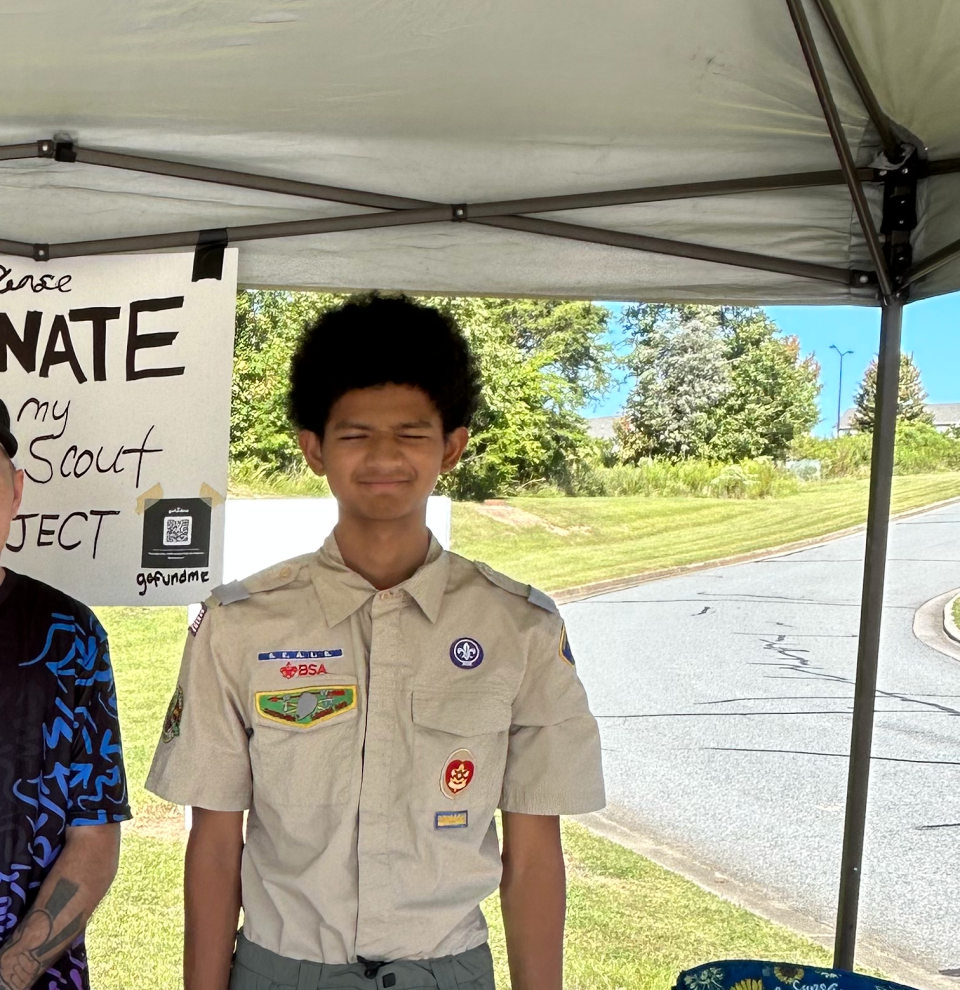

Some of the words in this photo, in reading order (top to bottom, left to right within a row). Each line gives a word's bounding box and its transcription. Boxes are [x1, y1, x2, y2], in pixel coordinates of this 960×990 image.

[17, 397, 71, 440] my
[24, 425, 164, 489] Scout
[5, 510, 121, 560] JECT
[298, 663, 327, 676] BSA
